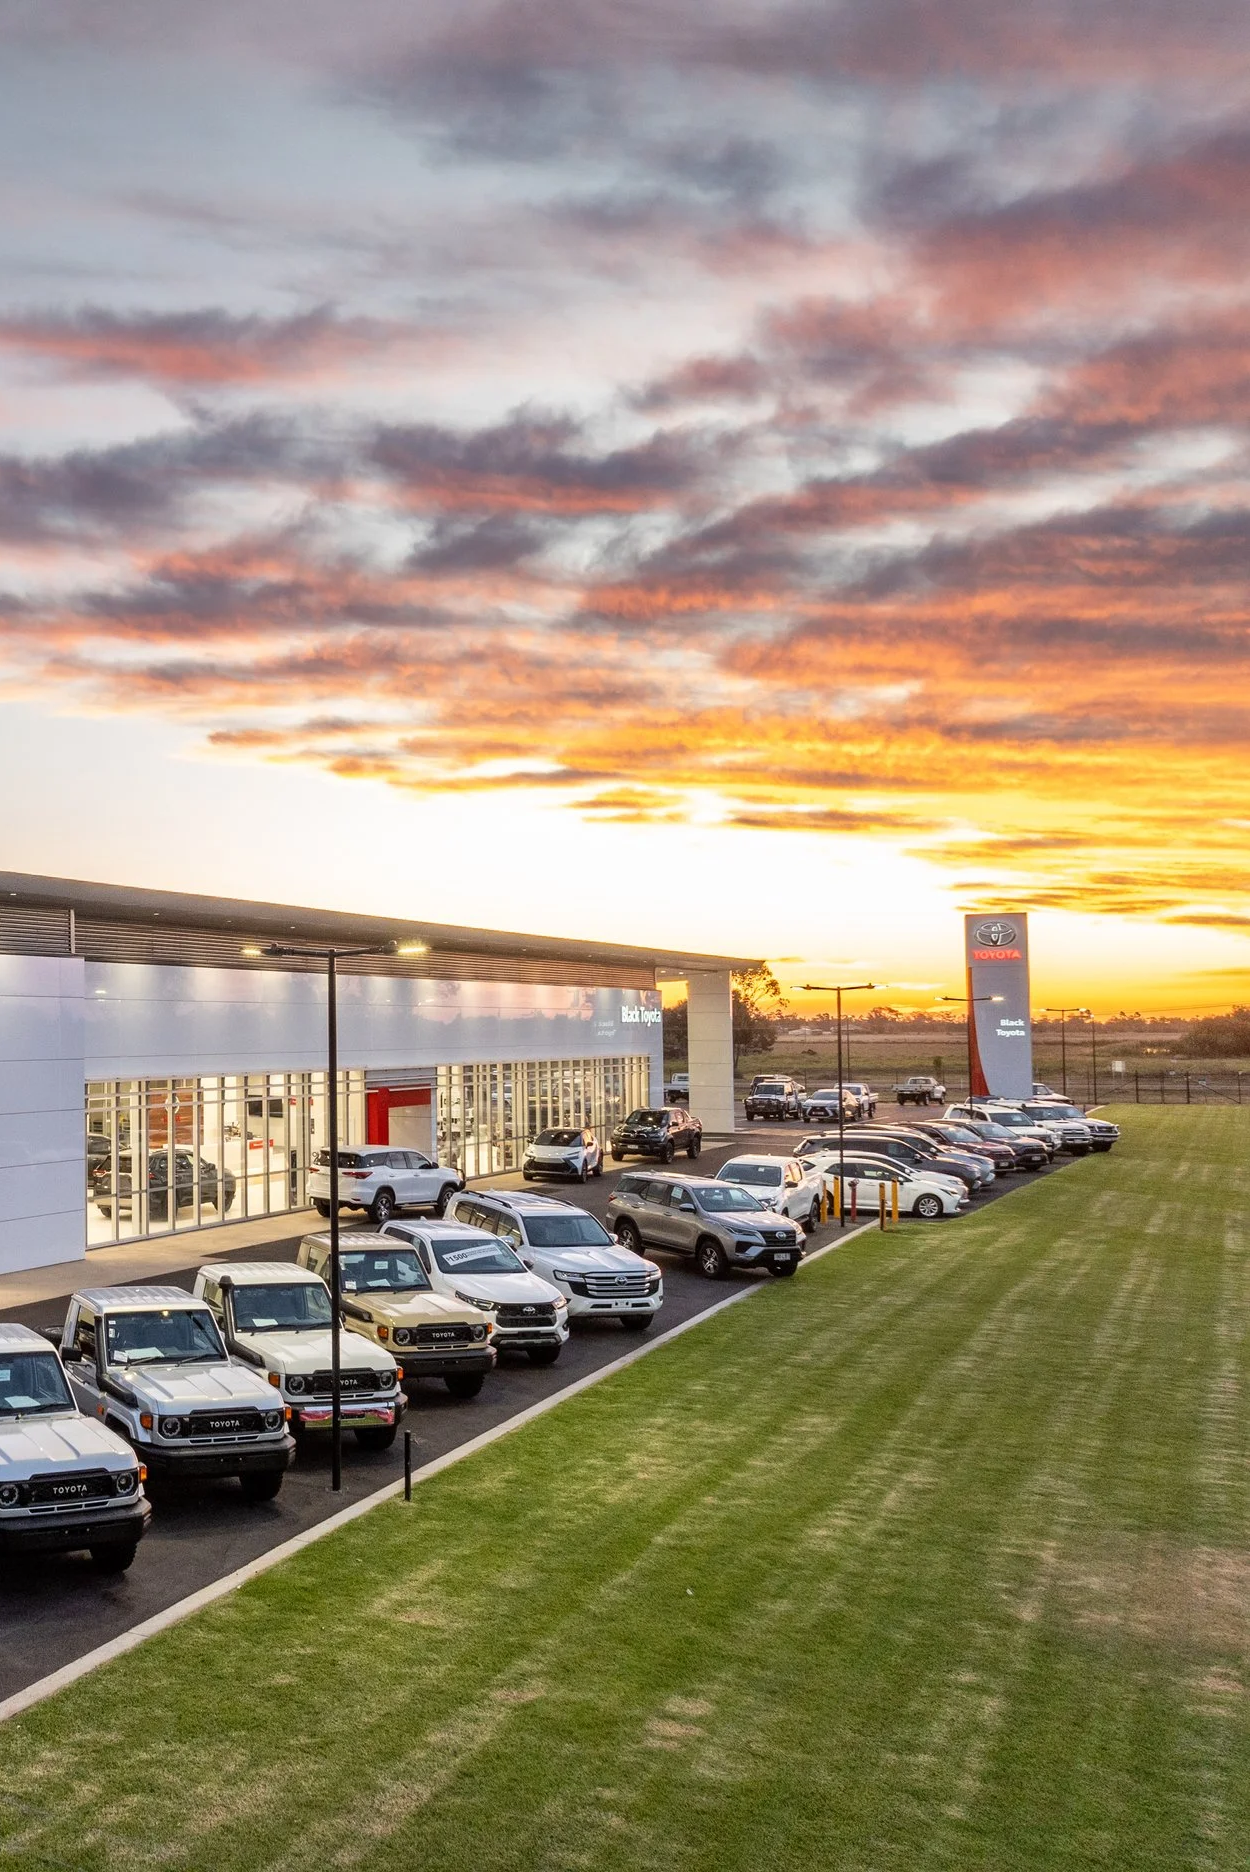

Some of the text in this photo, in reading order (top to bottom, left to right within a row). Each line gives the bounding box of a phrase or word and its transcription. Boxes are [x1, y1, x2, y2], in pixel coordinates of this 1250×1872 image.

[973, 949, 1022, 960] TOYOTA
[621, 1005, 661, 1027] Black Toyota
[995, 1029, 1025, 1037] Toyota
[210, 1420, 240, 1428] TOYOTA
[52, 1484, 88, 1494] TOYOTA
